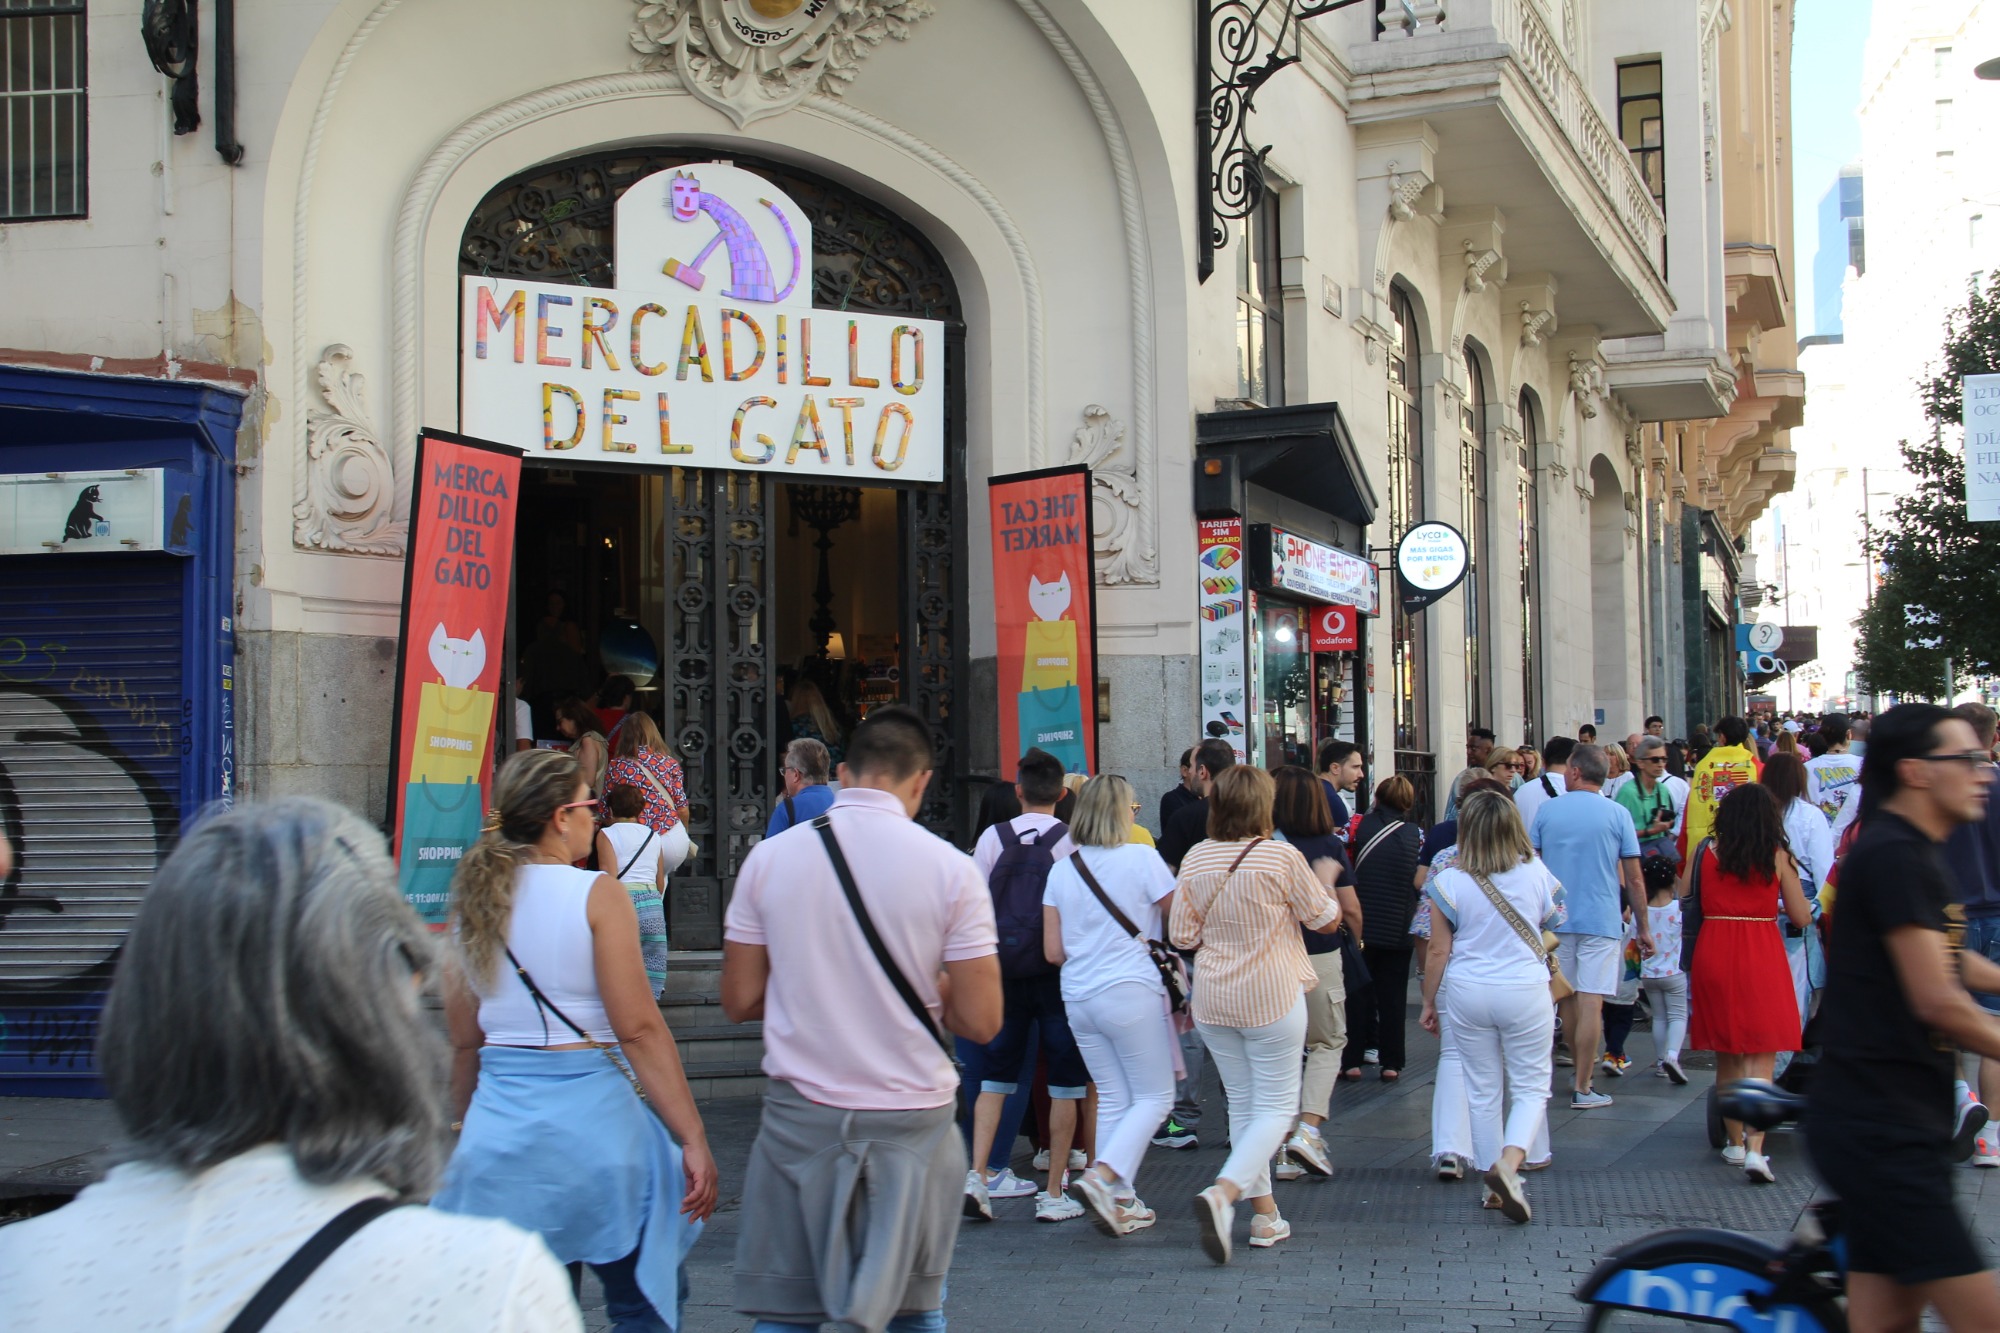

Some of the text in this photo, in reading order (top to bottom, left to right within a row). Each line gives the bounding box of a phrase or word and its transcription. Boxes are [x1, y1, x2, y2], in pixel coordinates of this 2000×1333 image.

[475, 285, 925, 396] MERCADILLO
[542, 381, 914, 472] DEL GATO
[434, 460, 509, 499] MERCA
[437, 493, 499, 528] DILLO
[1201, 519, 1241, 528] TARJETA
[446, 526, 486, 558] DEL
[1201, 536, 1241, 545] SIM CARD
[1212, 528, 1229, 536] SIM
[1416, 531, 1441, 540] Lyca
[1287, 538, 1327, 573] PHONE
[434, 557, 491, 590] GATO
[1316, 637, 1353, 645] vodafone
[429, 735, 473, 752] SHOPPING
